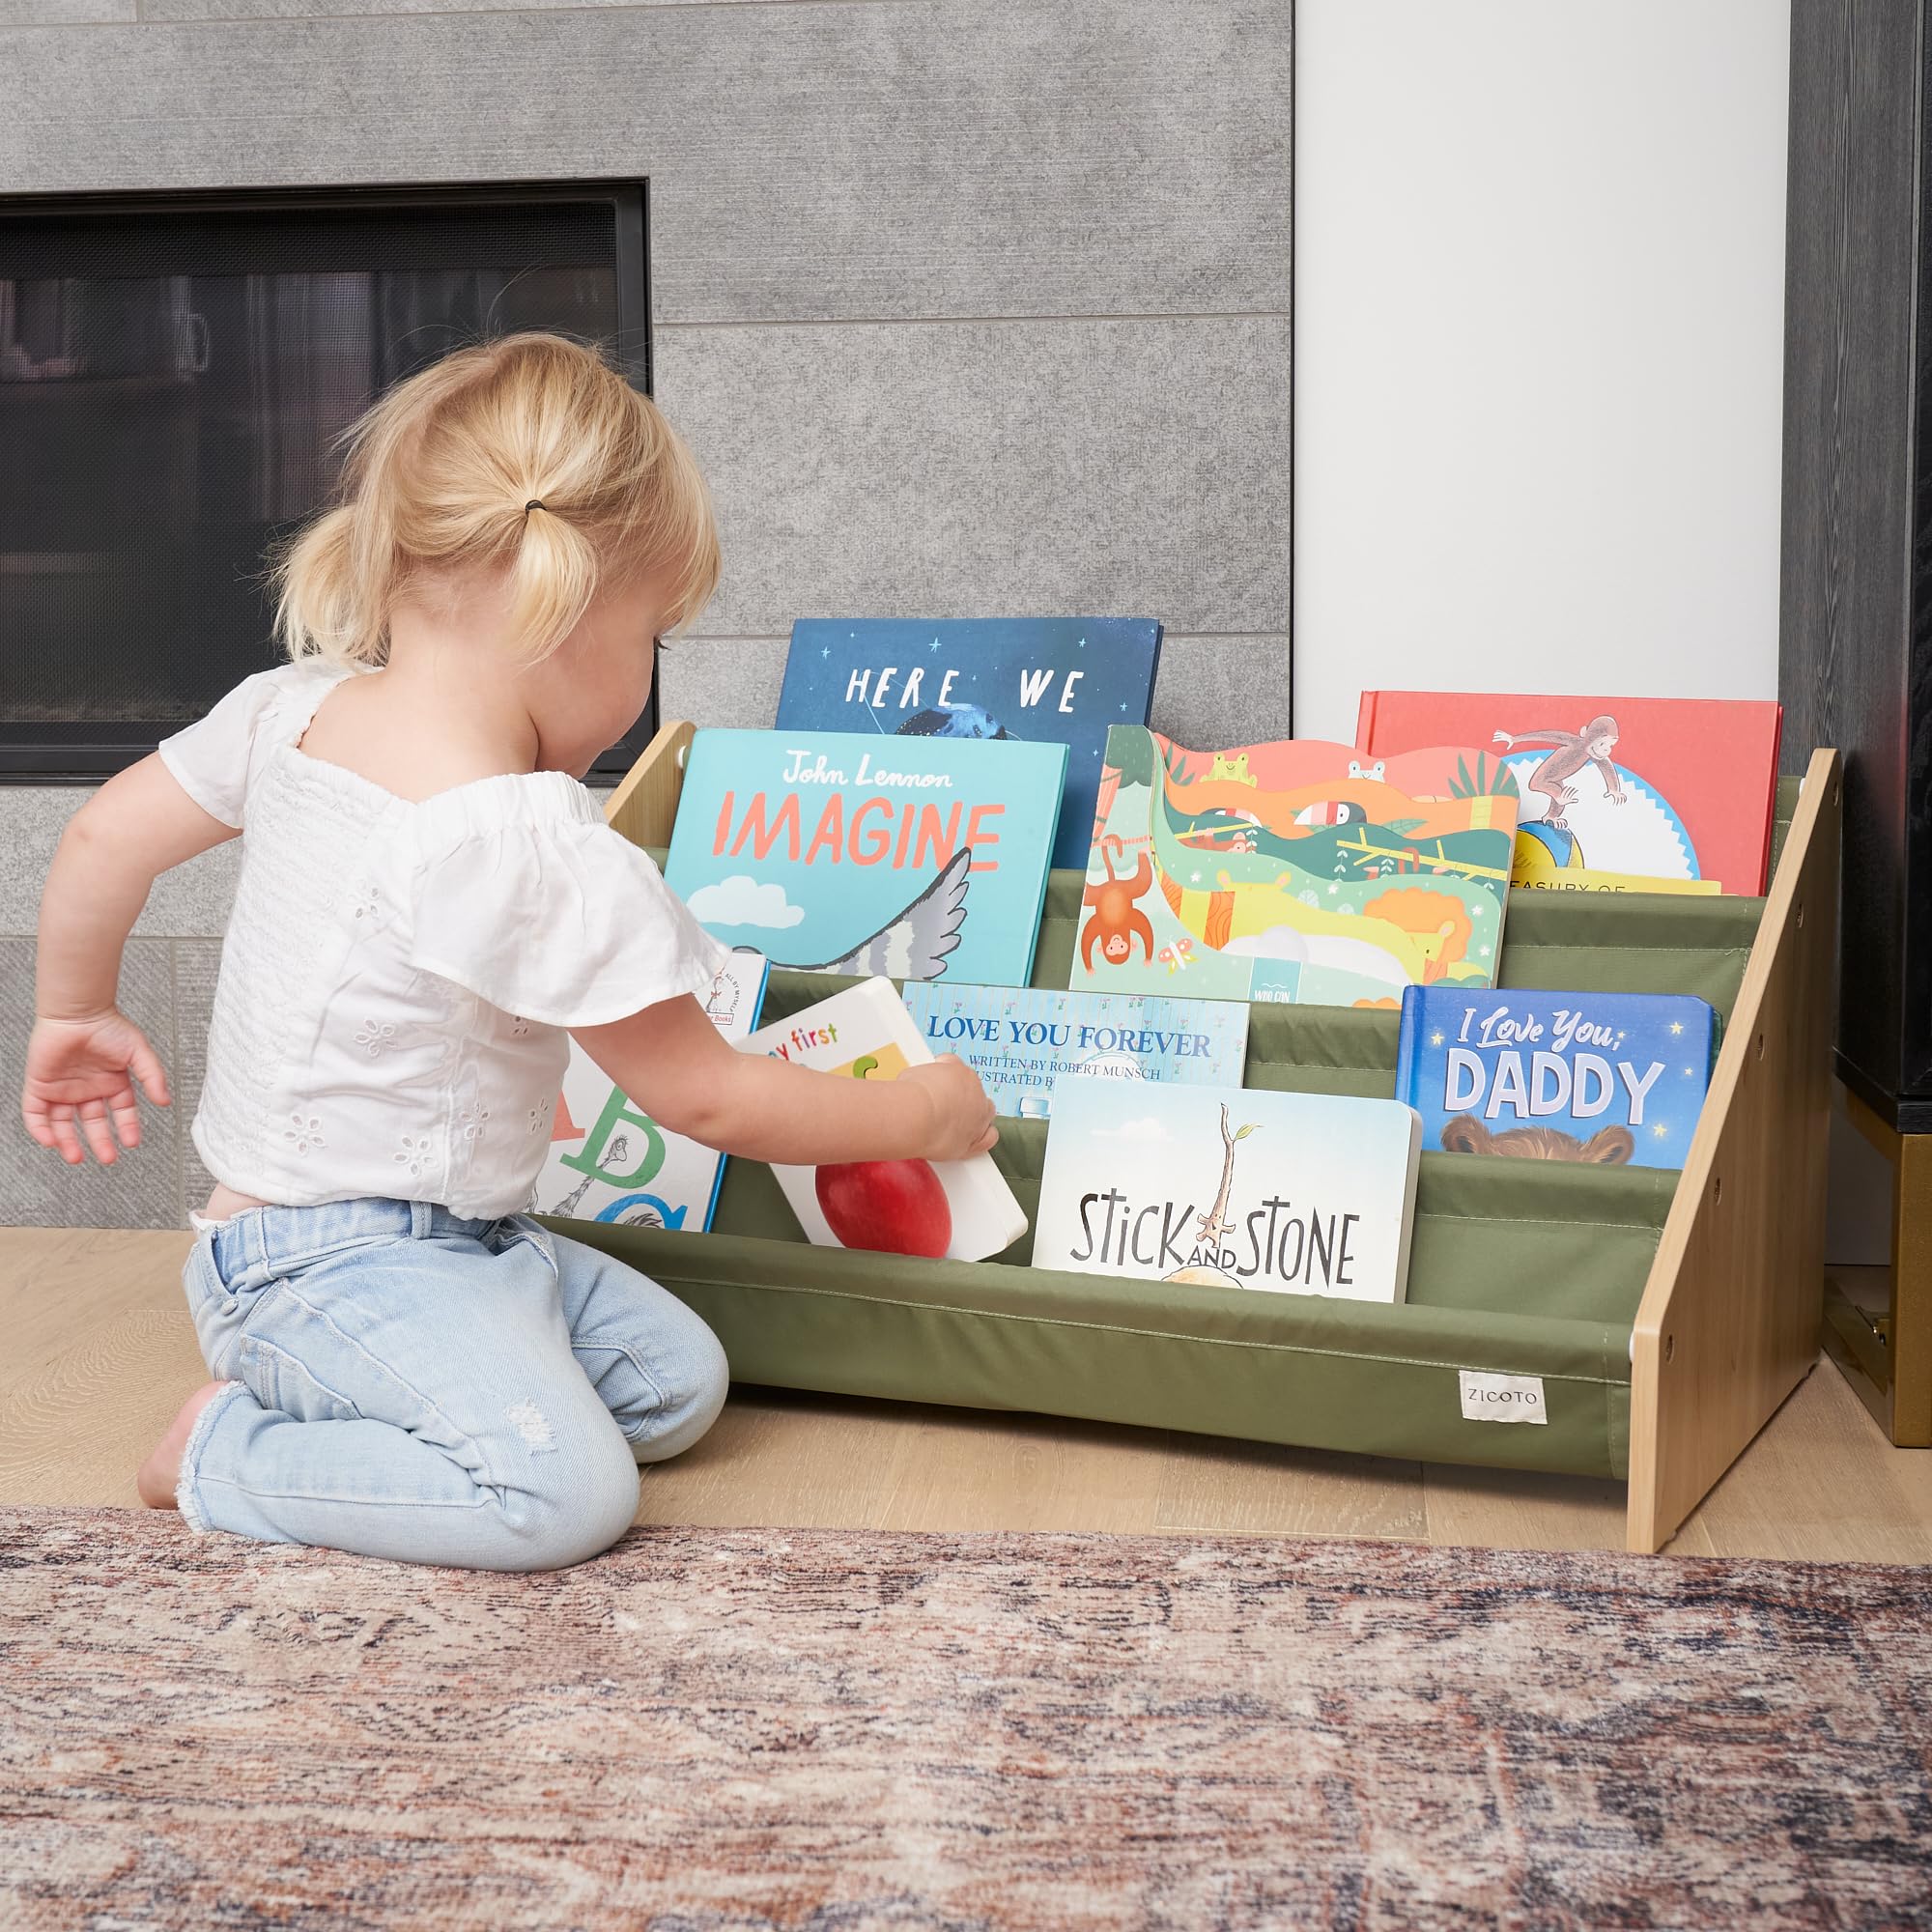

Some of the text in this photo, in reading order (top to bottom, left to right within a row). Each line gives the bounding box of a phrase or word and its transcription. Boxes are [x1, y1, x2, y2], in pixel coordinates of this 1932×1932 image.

[845, 668, 1084, 713] HERE WE
[782, 750, 953, 788] John Lennon
[712, 790, 1006, 872] IMAGINE
[1510, 880, 1589, 891] EASURY
[768, 1023, 838, 1061] y first
[927, 1015, 1212, 1058] LOVE YOU FOREVER
[1457, 1006, 1621, 1053] I Love You,
[969, 1055, 1161, 1081] WRITTEN BY ROBERT MUNSCH
[977, 1070, 1057, 1087] USTRATED B
[1444, 1047, 1666, 1125] DADDY
[1186, 1245, 1236, 1269] AND
[1468, 1388, 1537, 1405] ZICOTO
